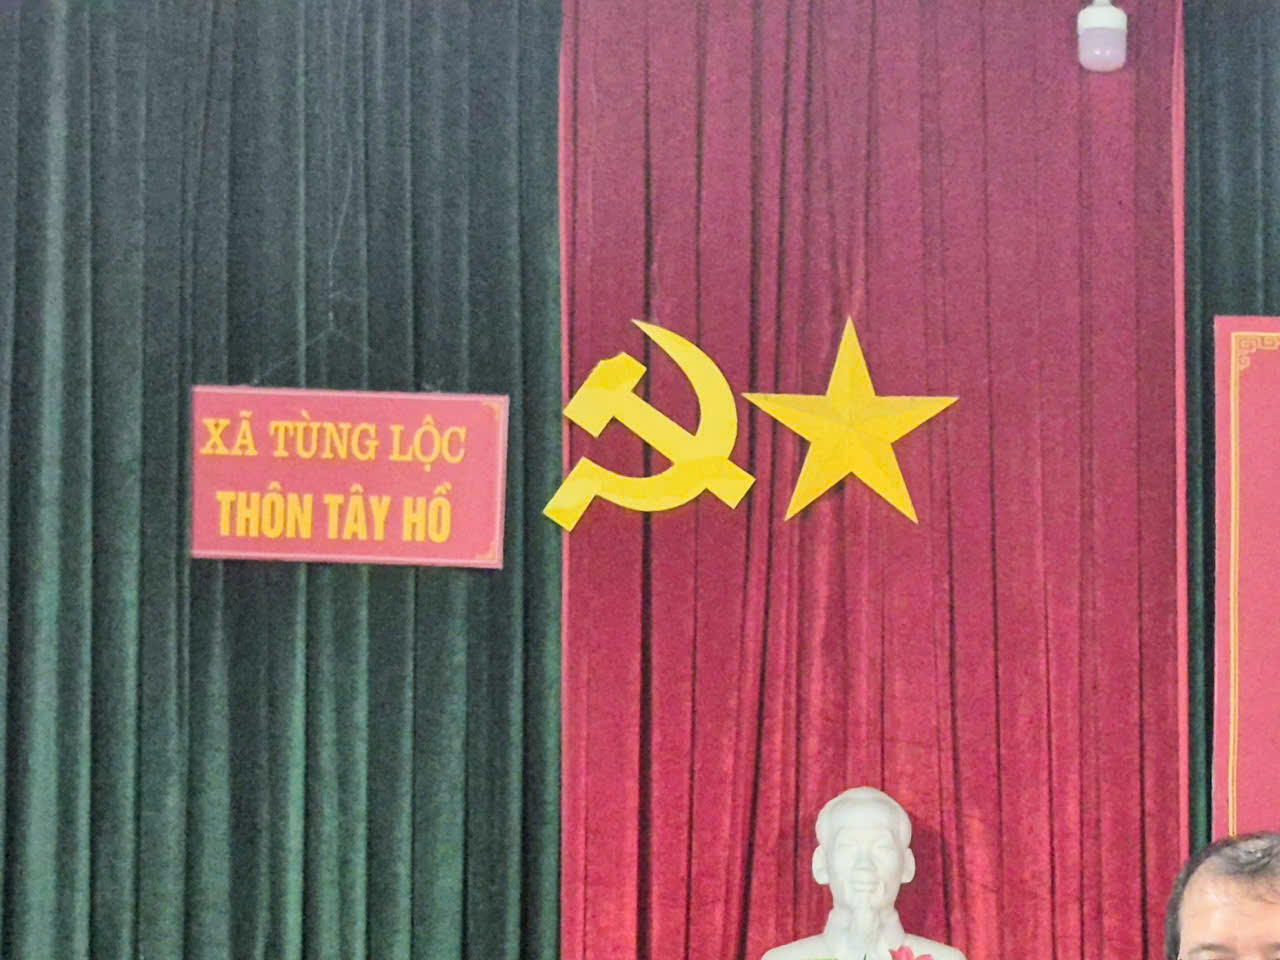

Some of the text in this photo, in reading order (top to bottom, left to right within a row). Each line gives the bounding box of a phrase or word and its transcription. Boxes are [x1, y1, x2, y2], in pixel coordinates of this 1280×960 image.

[200, 409, 467, 473] XÃ TÙNG LỘC
[216, 480, 452, 544] THÔN TÂY HỒ
